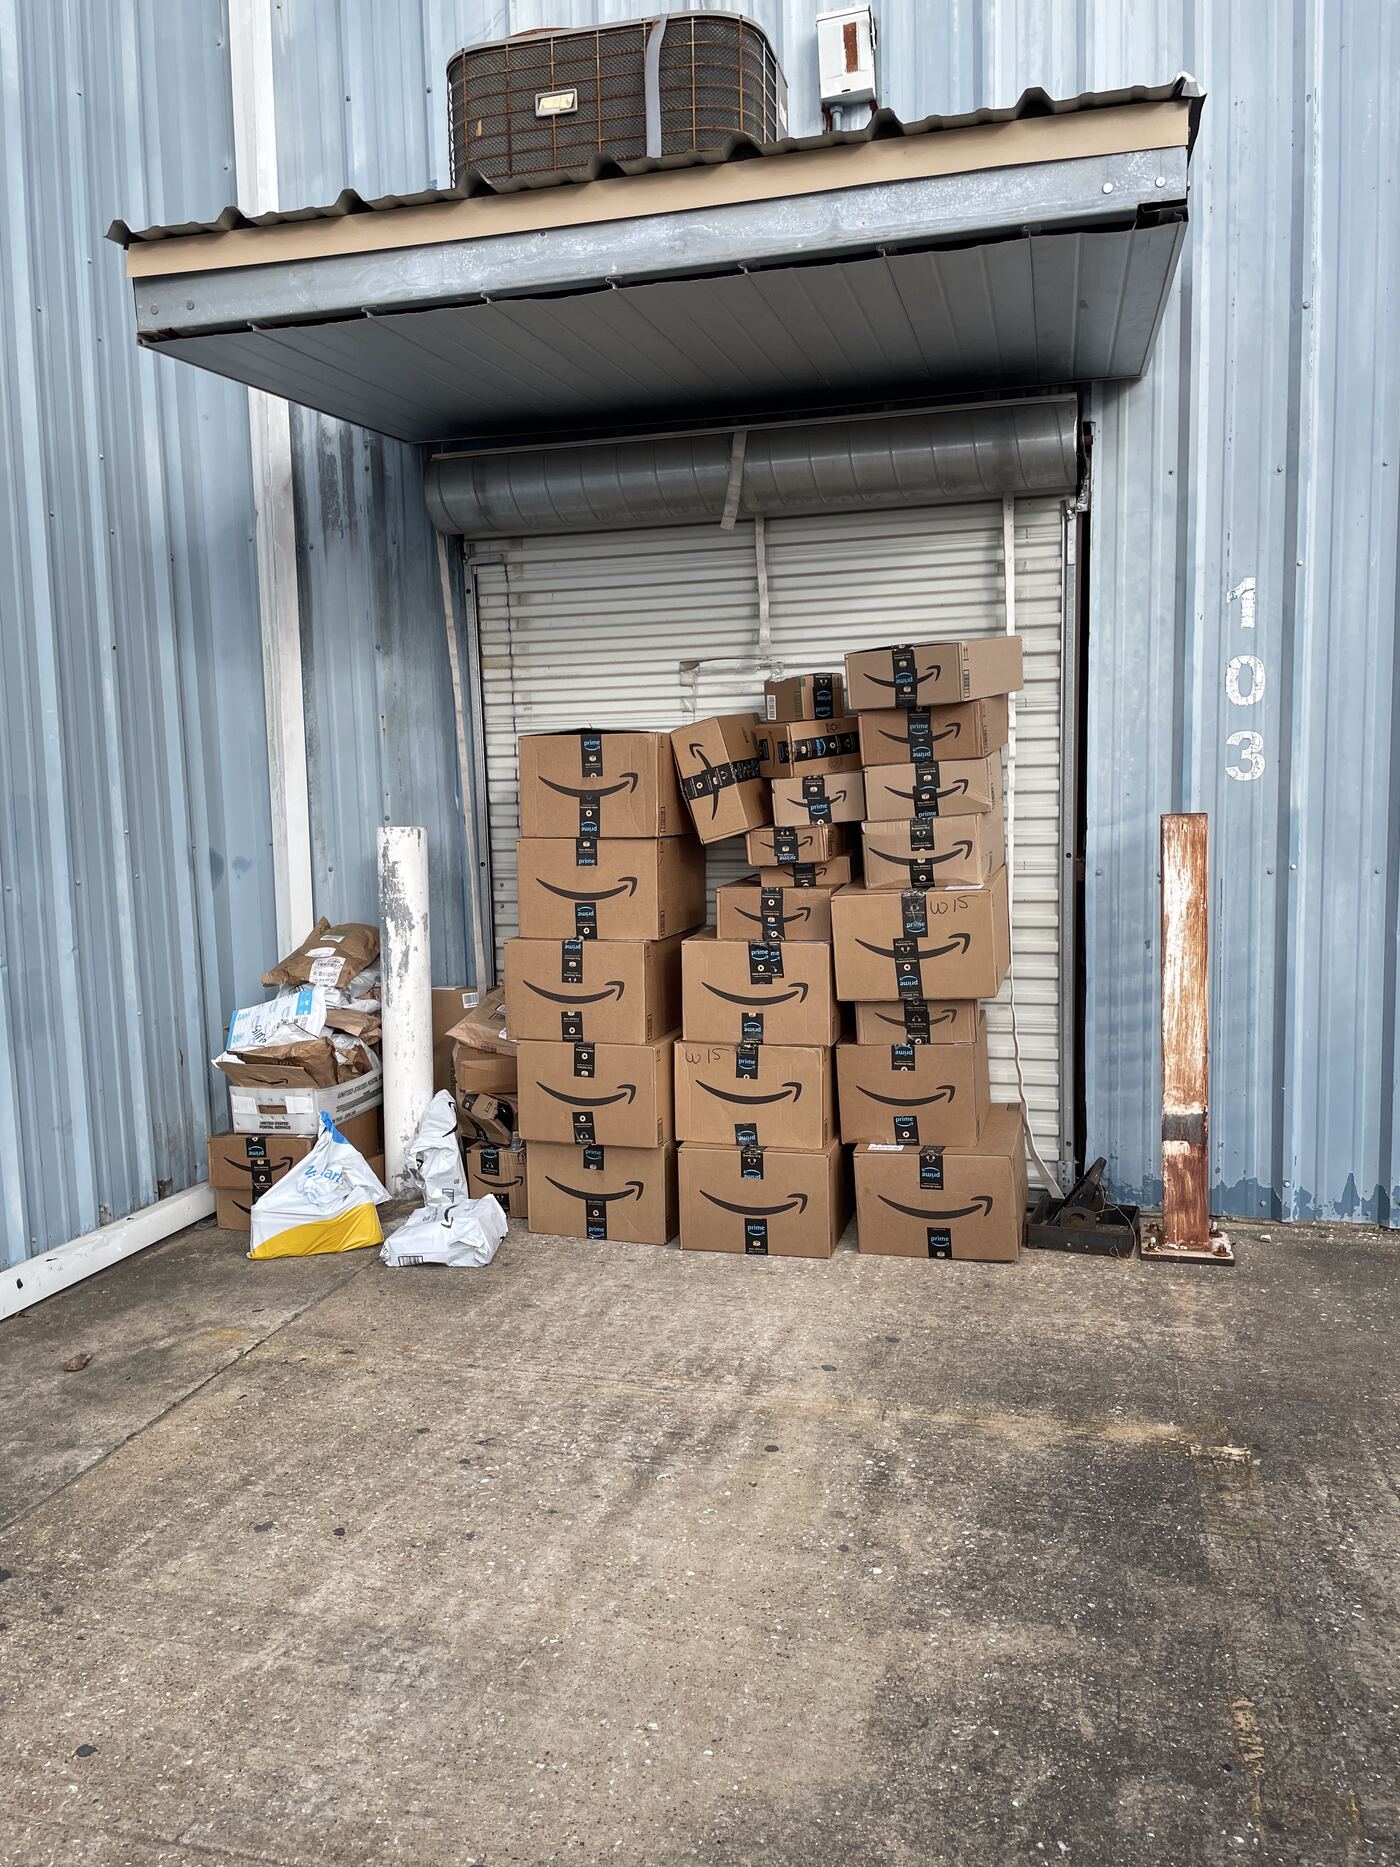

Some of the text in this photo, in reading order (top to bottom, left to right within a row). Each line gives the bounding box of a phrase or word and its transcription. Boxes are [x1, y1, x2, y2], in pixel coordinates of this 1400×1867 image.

[1225, 577, 1266, 781] 103
[910, 722, 929, 730] prime
[810, 803, 828, 811] prime
[918, 810, 937, 818] prime
[751, 948, 769, 956] prime
[894, 1049, 913, 1057] prime
[747, 1224, 766, 1232] prime
[930, 1235, 950, 1243] prime
